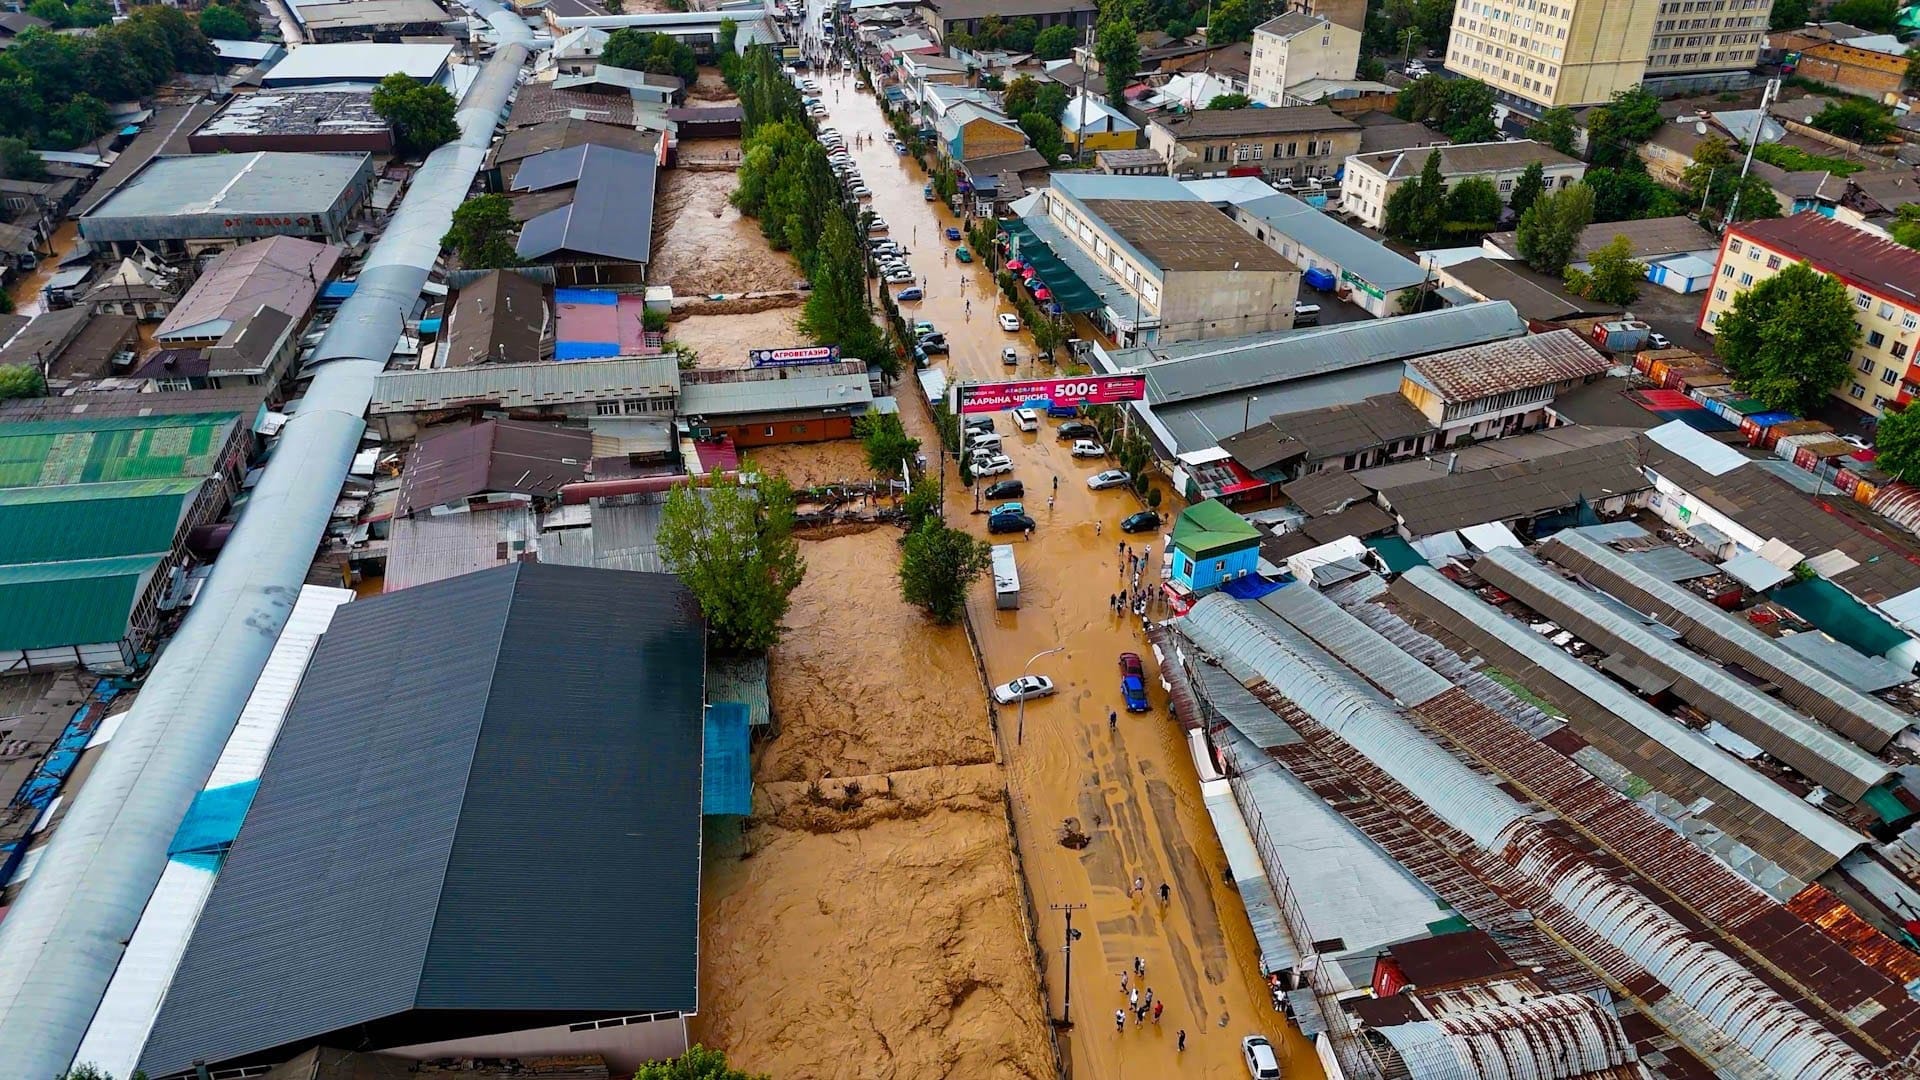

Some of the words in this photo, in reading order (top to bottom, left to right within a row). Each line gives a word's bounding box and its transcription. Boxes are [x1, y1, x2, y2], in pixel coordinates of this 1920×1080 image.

[774, 349, 828, 358] АГРОВЕТАЗИЯ
[963, 396, 1011, 406] БААРЫНА
[1013, 393, 1049, 402] ЧЕКСИЗ
